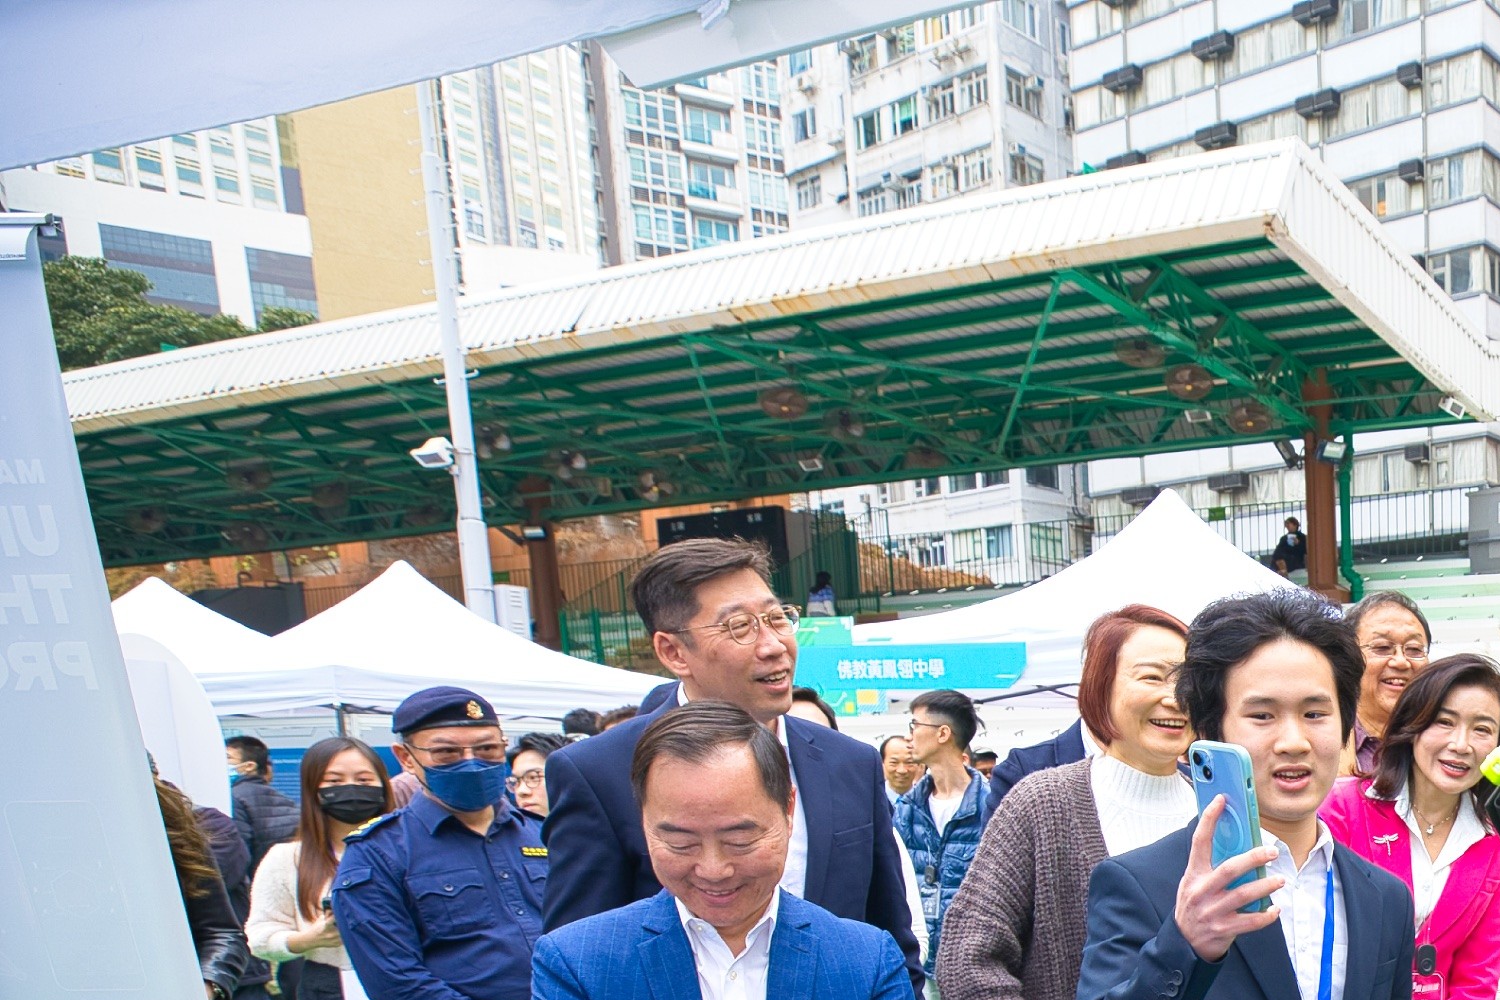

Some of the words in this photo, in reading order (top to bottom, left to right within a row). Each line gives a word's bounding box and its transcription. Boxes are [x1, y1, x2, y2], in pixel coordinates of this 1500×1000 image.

[837, 658, 945, 680] 佛教黃鳳翎中學
